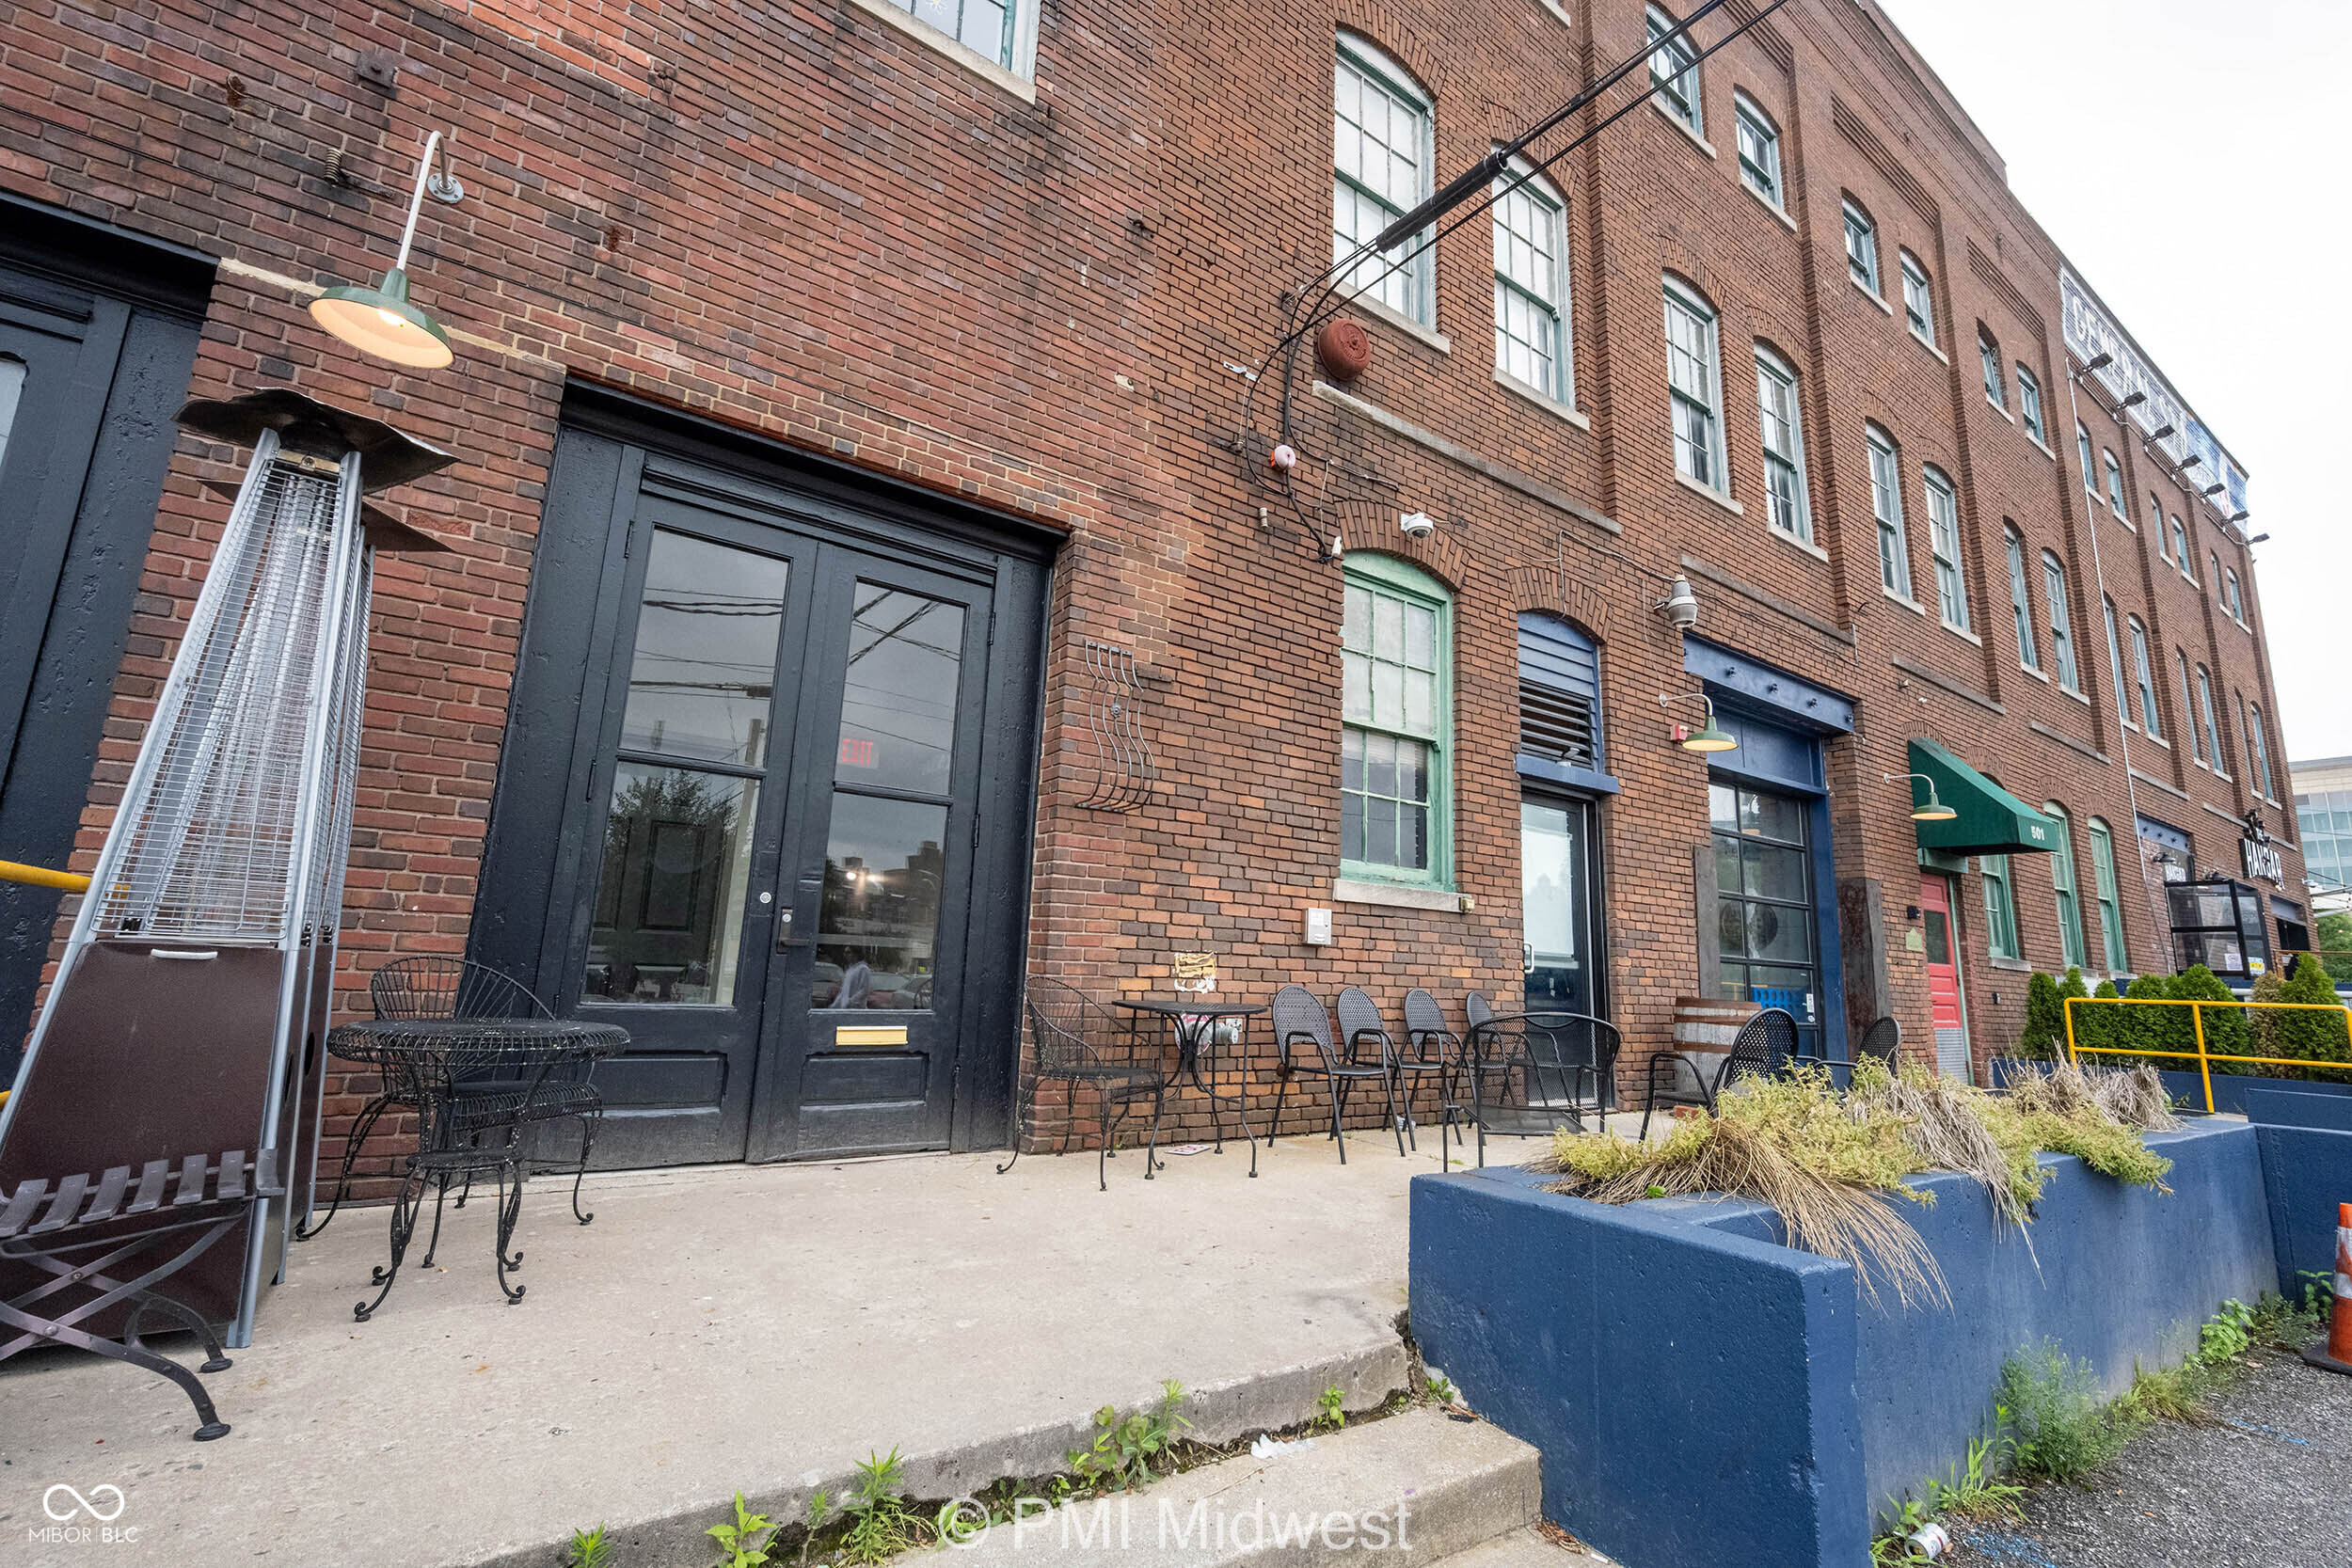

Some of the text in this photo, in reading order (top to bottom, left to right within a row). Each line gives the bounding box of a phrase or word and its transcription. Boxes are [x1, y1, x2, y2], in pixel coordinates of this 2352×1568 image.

[842, 738, 874, 766] EXIT
[2030, 825, 2045, 841] 501
[2244, 838, 2286, 890] HANGAR
